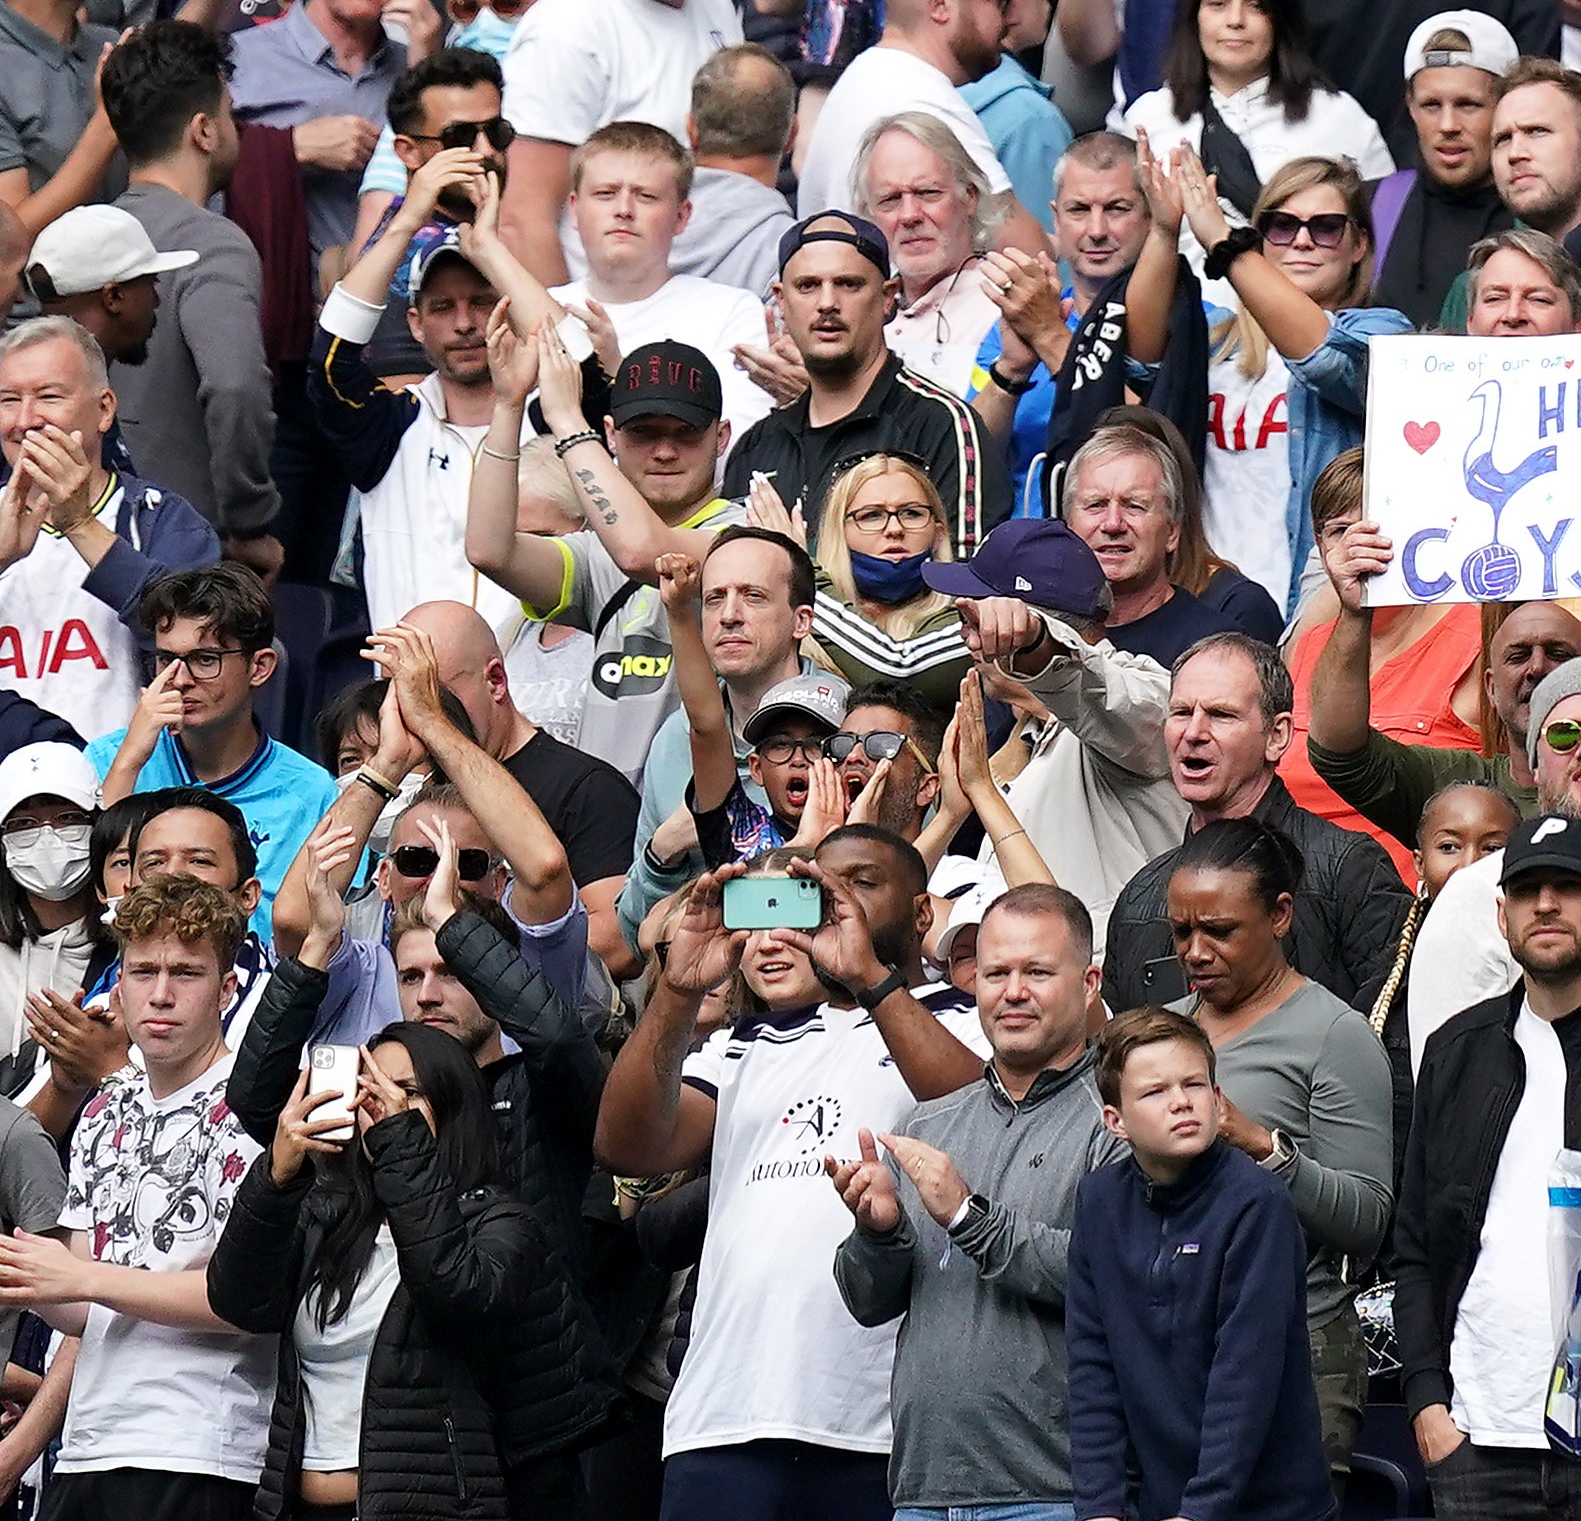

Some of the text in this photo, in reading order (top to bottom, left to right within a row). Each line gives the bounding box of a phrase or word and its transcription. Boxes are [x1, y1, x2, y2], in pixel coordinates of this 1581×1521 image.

[1424, 355, 1455, 373] One
[1467, 353, 1488, 378] of
[1502, 358, 1532, 372] our
[0, 618, 109, 680] AIA
[1530, 816, 1568, 845] P
[747, 1156, 867, 1187] Autono
